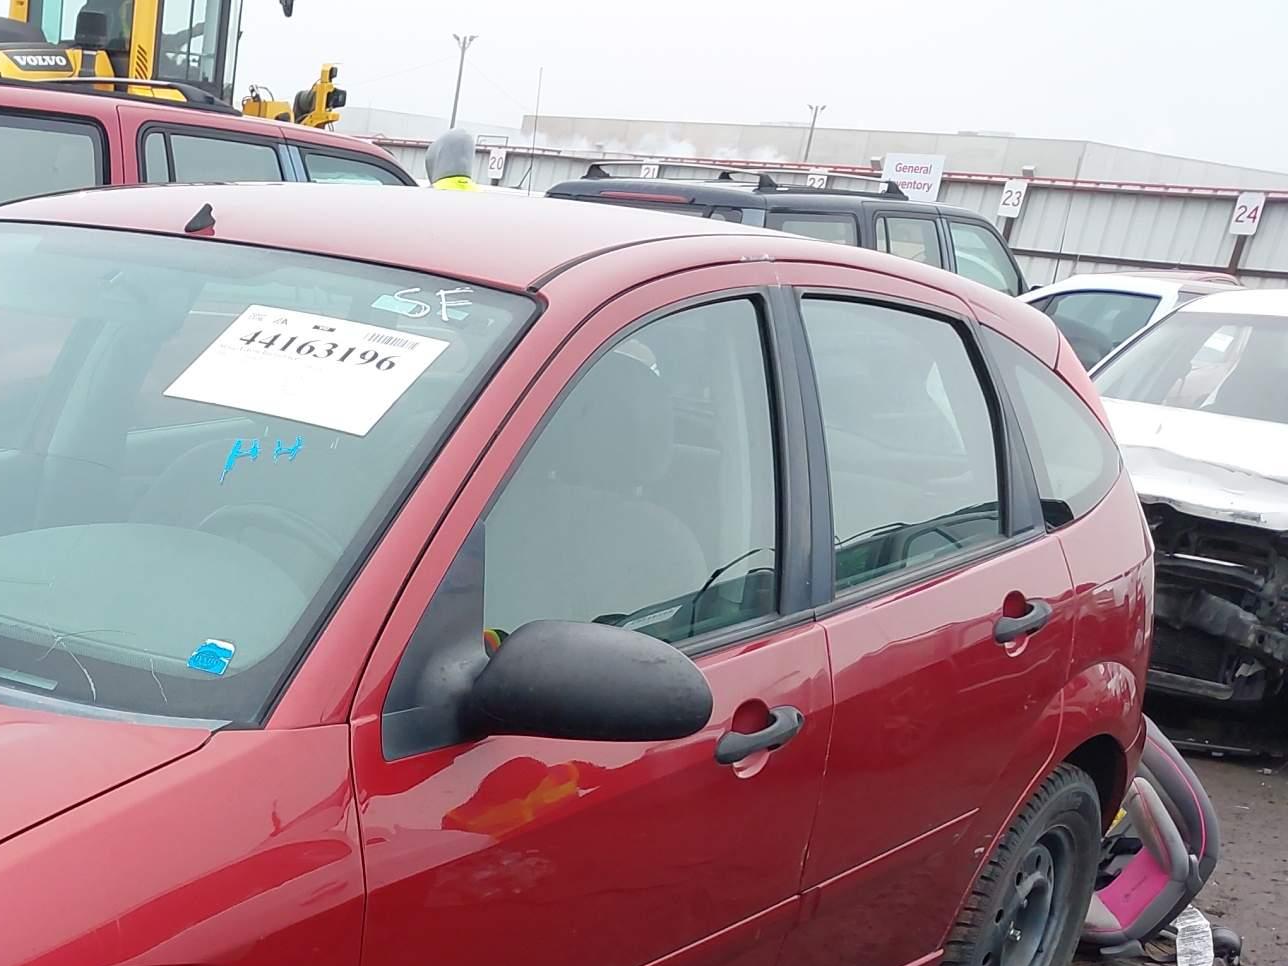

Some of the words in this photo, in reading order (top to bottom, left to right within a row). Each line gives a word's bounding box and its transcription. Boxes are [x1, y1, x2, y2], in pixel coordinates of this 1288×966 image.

[13, 55, 67, 66] VOLVO
[489, 156, 504, 170] 20
[895, 162, 933, 174] General
[895, 180, 933, 193] ventory
[1002, 189, 1022, 207] 23
[1234, 204, 1260, 224] 24
[239, 329, 401, 372] 44163196
